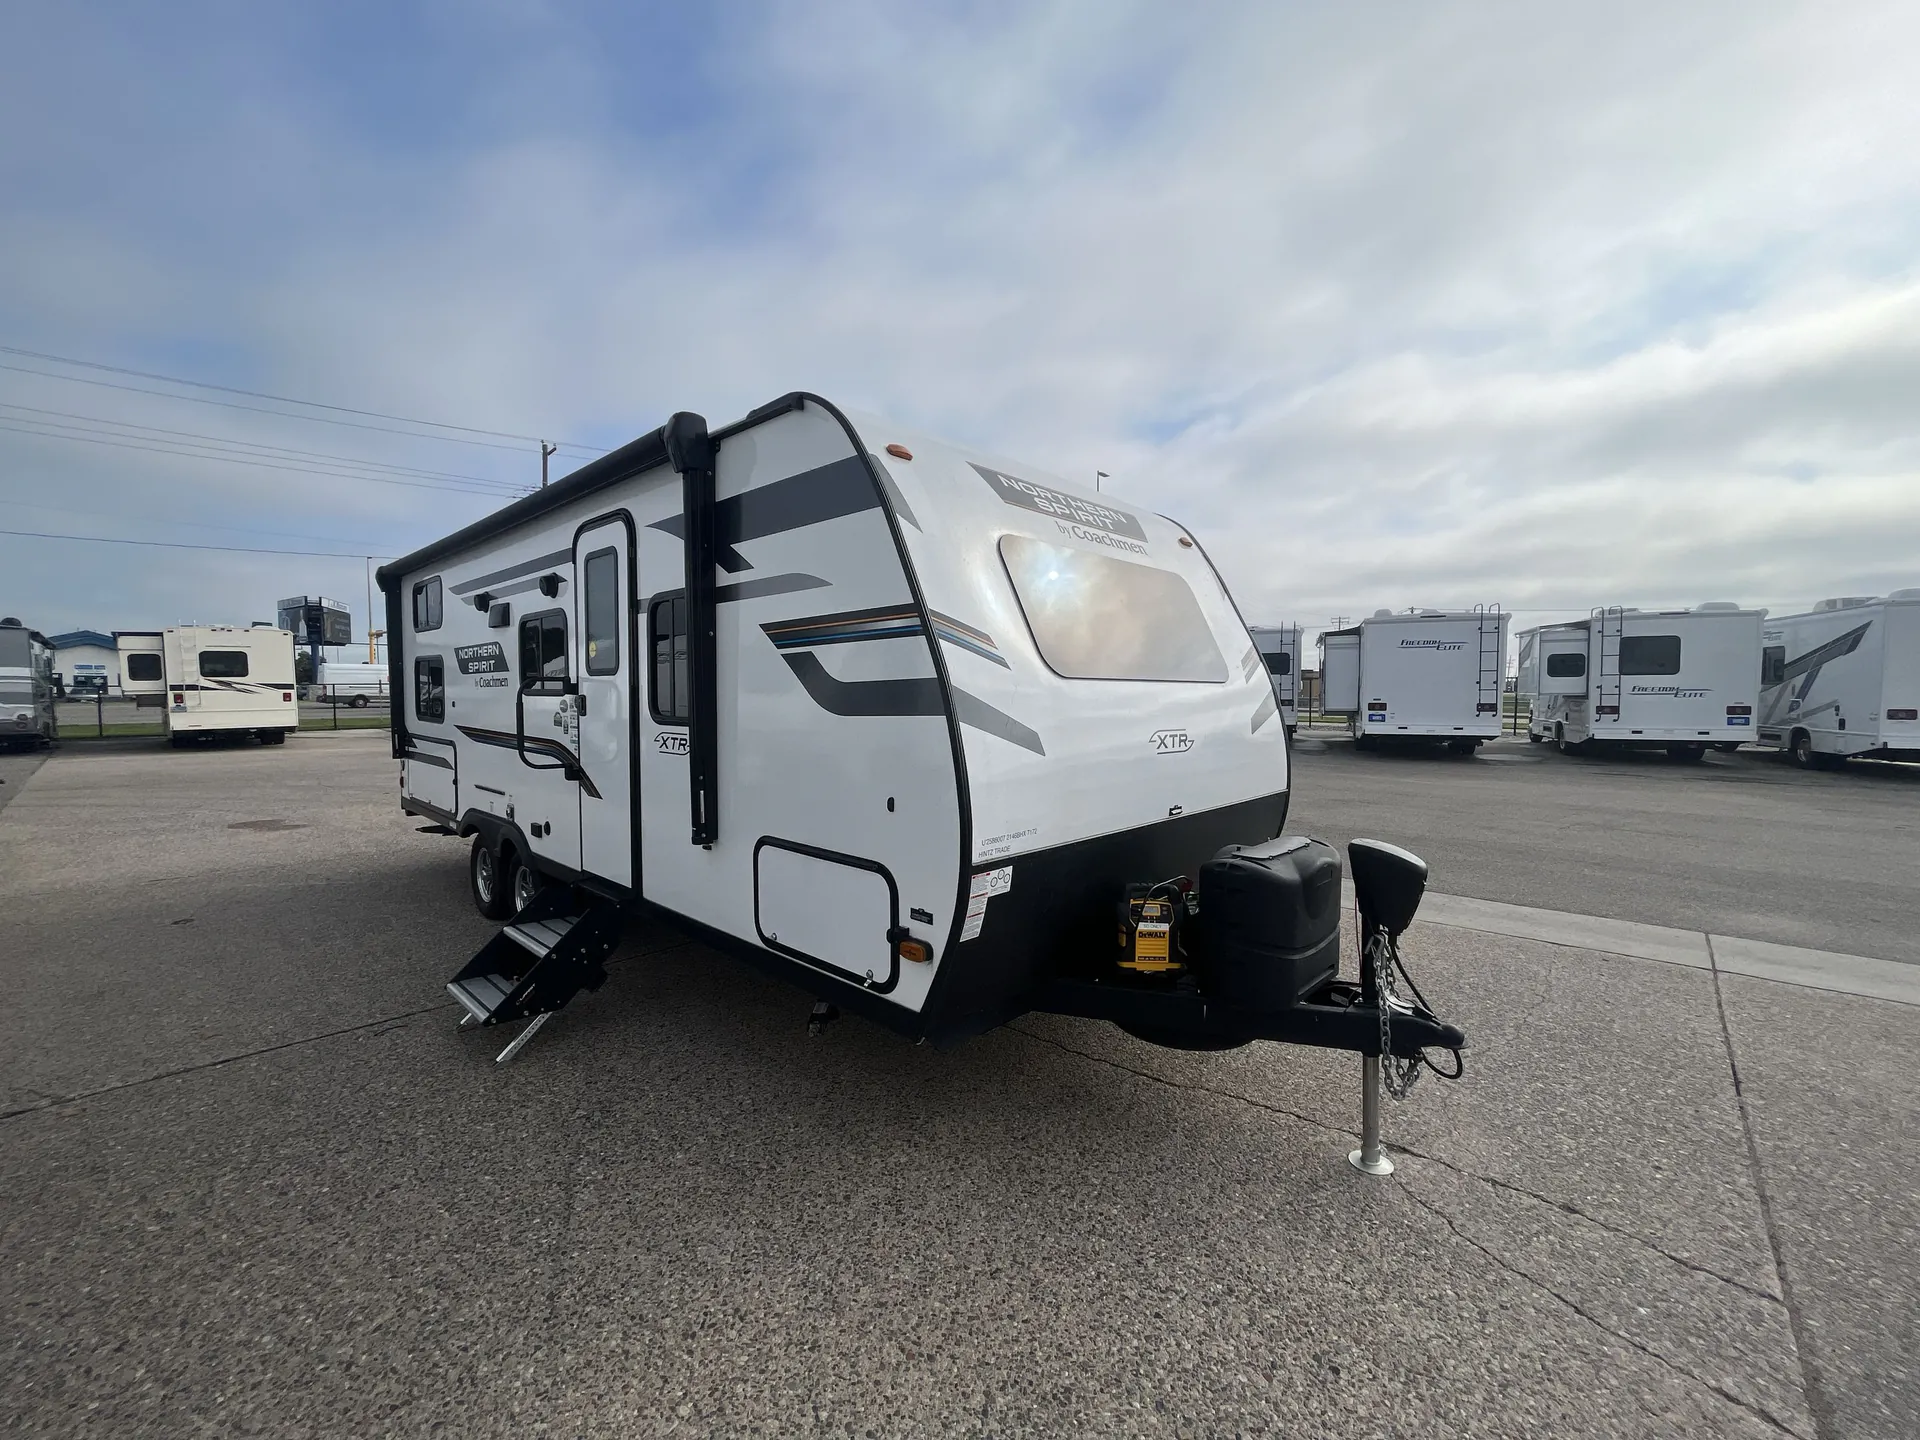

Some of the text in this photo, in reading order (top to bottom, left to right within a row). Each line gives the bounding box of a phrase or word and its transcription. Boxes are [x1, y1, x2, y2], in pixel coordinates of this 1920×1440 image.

[996, 474, 1127, 524] NORTHERN
[1033, 497, 1114, 530] SPIRIT
[1055, 520, 1149, 556] by Coachmen
[458, 644, 499, 660] NORTHERN
[468, 660, 495, 673] SPIRIT
[479, 675, 509, 688] Coachmen
[1674, 690, 1706, 698] ELITE
[659, 735, 688, 751] XTR
[1156, 733, 1188, 750] XTR
[994, 845, 1011, 855] TRADE
[1138, 931, 1167, 939] DeWALT
